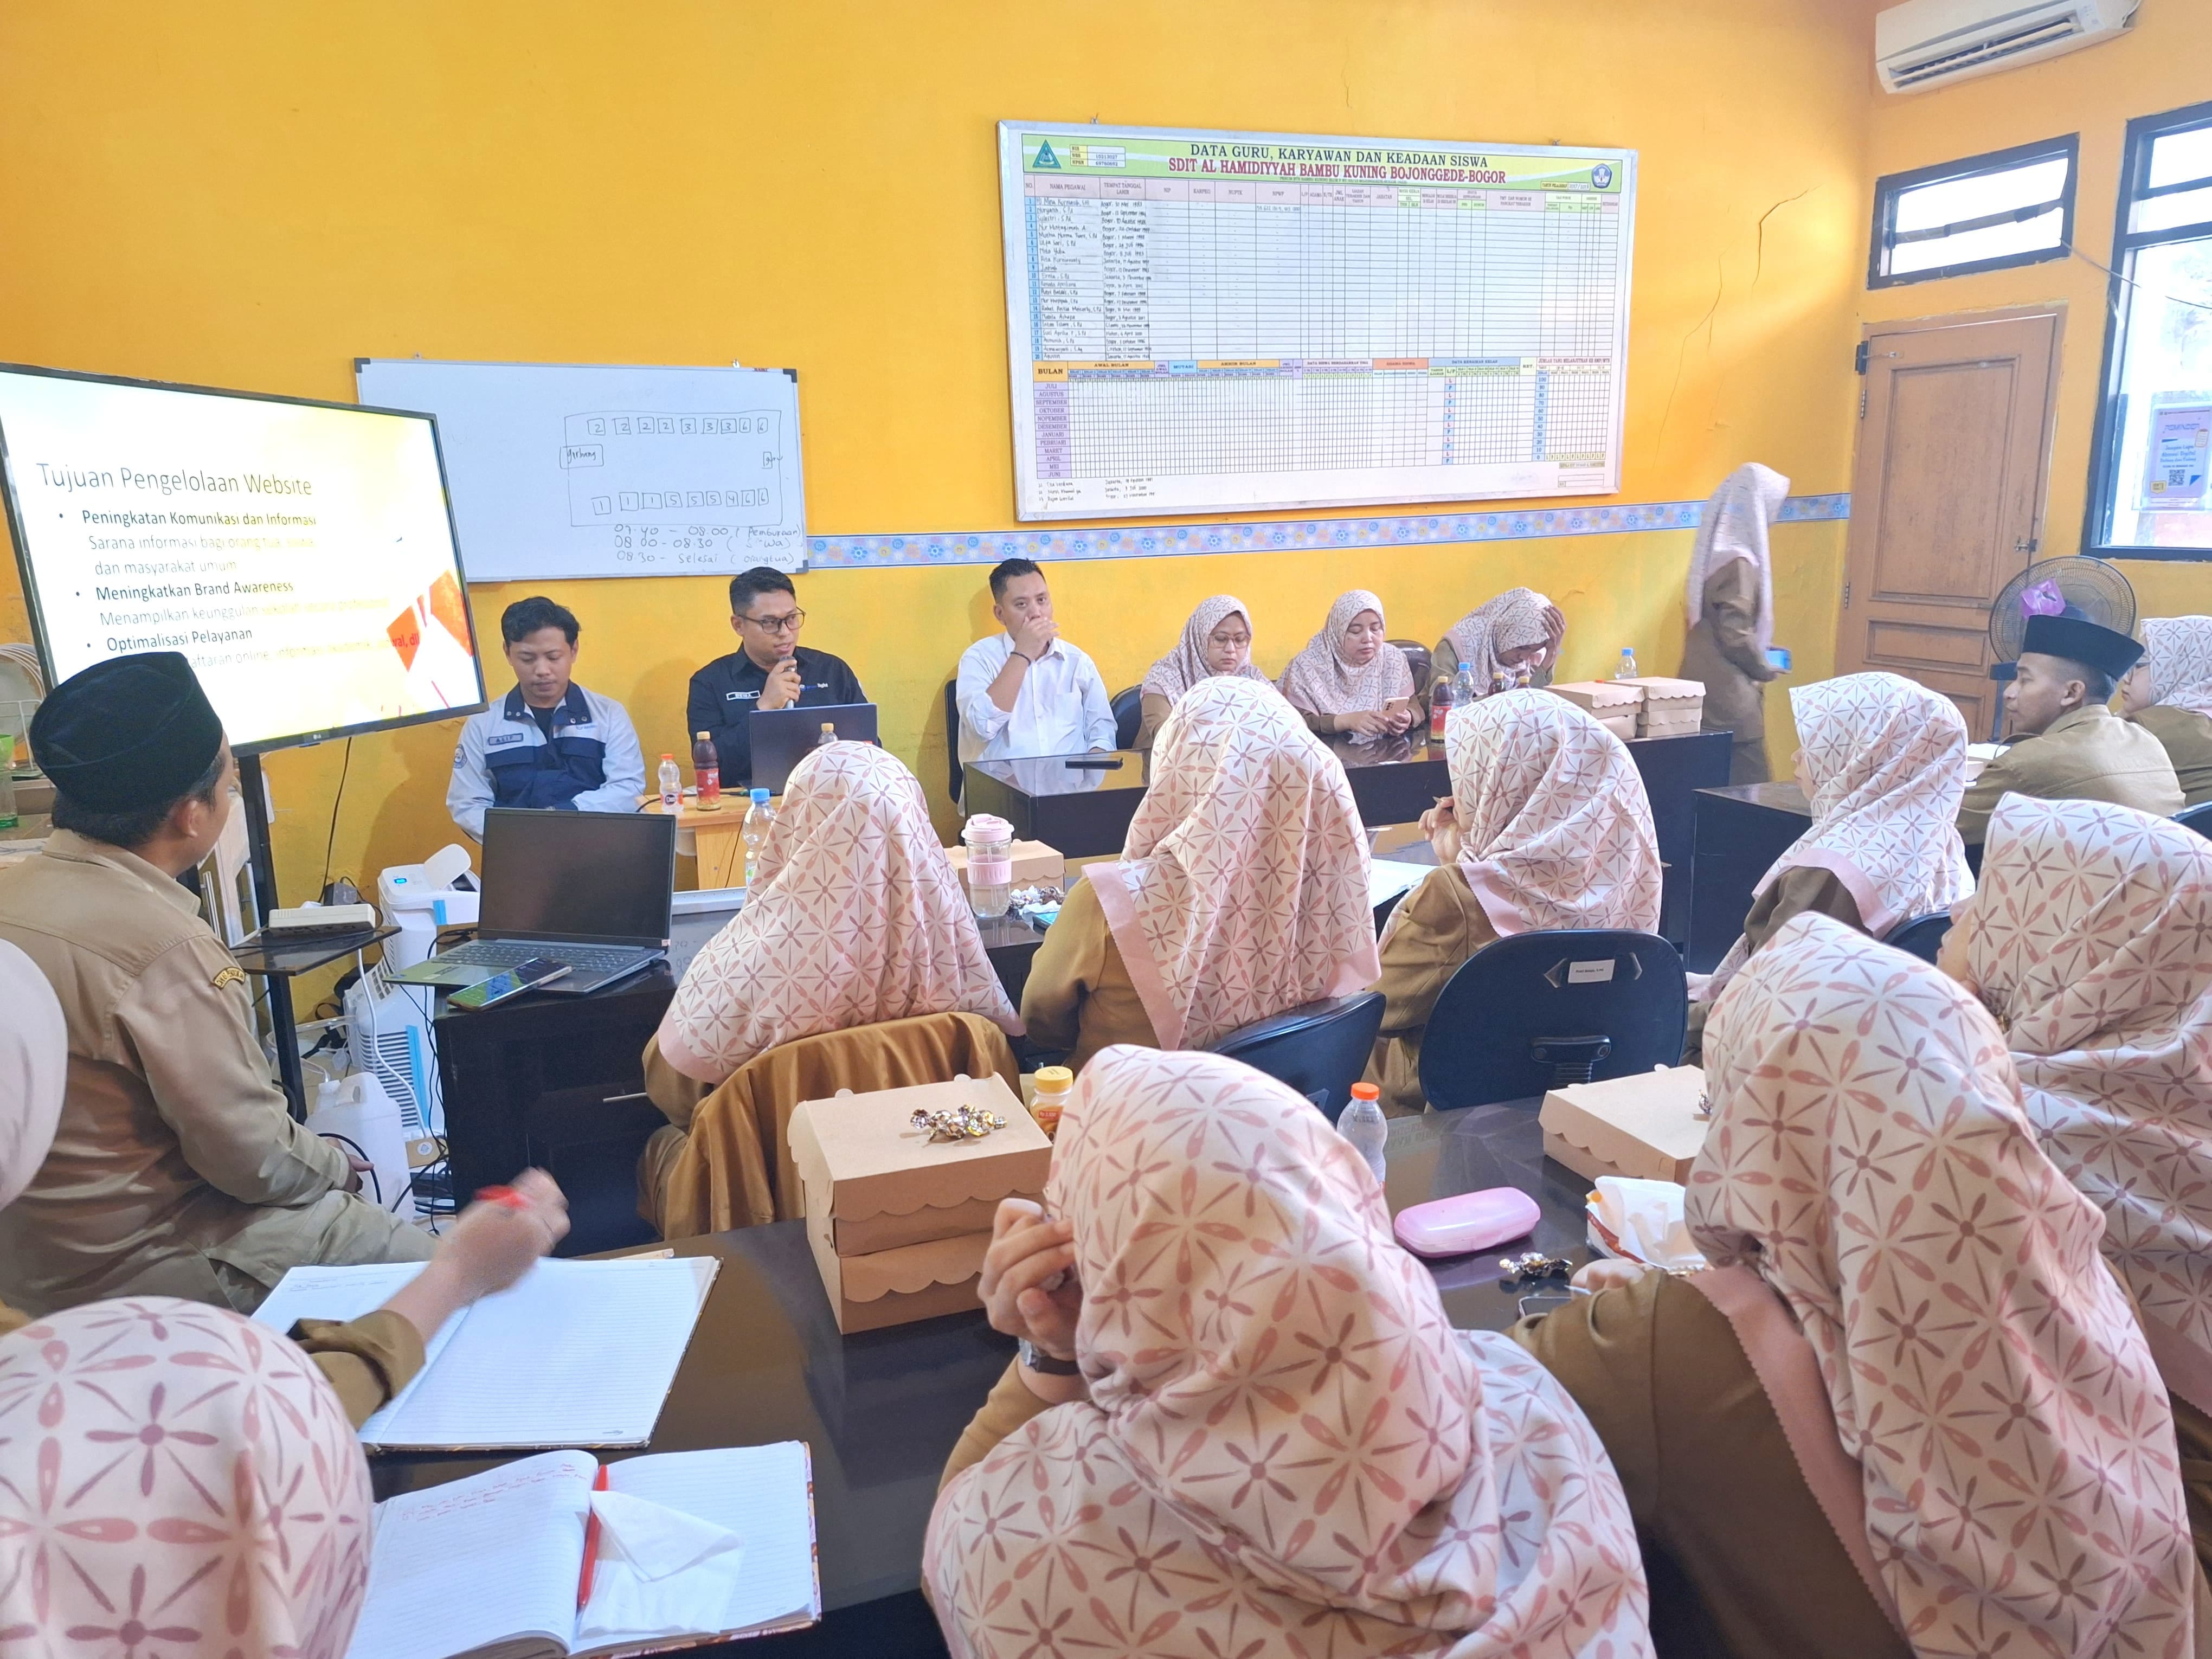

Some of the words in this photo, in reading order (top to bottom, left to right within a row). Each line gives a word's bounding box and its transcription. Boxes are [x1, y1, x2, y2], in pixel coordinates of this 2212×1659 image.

[1191, 144, 1227, 157] DATA
[1232, 146, 1274, 161] GURU,
[1278, 148, 1351, 162] KARYAWAN
[1356, 151, 1381, 163] DAN
[1386, 152, 1446, 166] KEADAAN
[1450, 155, 1488, 167] SISWA
[1168, 157, 1197, 172] SDIT
[1201, 159, 1217, 173] AL
[1220, 159, 1296, 176] HAMIDIYYAH
[1300, 163, 1340, 178] BAMBU
[1343, 164, 1387, 179] KUNING
[1390, 165, 1506, 184] BOJONGGEDE-BOGOR
[595, 424, 603, 433] 2
[621, 423, 629, 431] 2
[685, 423, 691, 432] 3
[706, 423, 713, 431] 3
[725, 422, 731, 430] 3
[36, 463, 114, 492] Tujuan
[120, 467, 239, 495] Pengelolaan
[243, 474, 312, 494] Website
[670, 495, 677, 505] 5
[691, 496, 697, 505] 5
[710, 495, 716, 503] 5
[728, 495, 734, 504] 4
[745, 494, 750, 503] 6
[82, 510, 166, 527] Peningkatan
[170, 511, 239, 525] Komunikasi
[243, 513, 263, 525] dan
[267, 513, 316, 525] Informasi
[89, 536, 134, 549] Sarana
[139, 535, 196, 549] informasi
[201, 533, 224, 551] bagi
[673, 538, 712, 548] 08.30
[95, 561, 120, 575] dan
[125, 560, 196, 576] masyarakat
[200, 562, 237, 573] umum
[96, 583, 191, 602] Meningkatkan
[195, 581, 229, 596] Brand
[234, 581, 293, 594] Awareness
[100, 608, 189, 625] Menampilkan
[192, 604, 259, 621] keunggulan
[107, 632, 188, 653] Optimalisasi
[192, 629, 252, 644] Pelayanan
